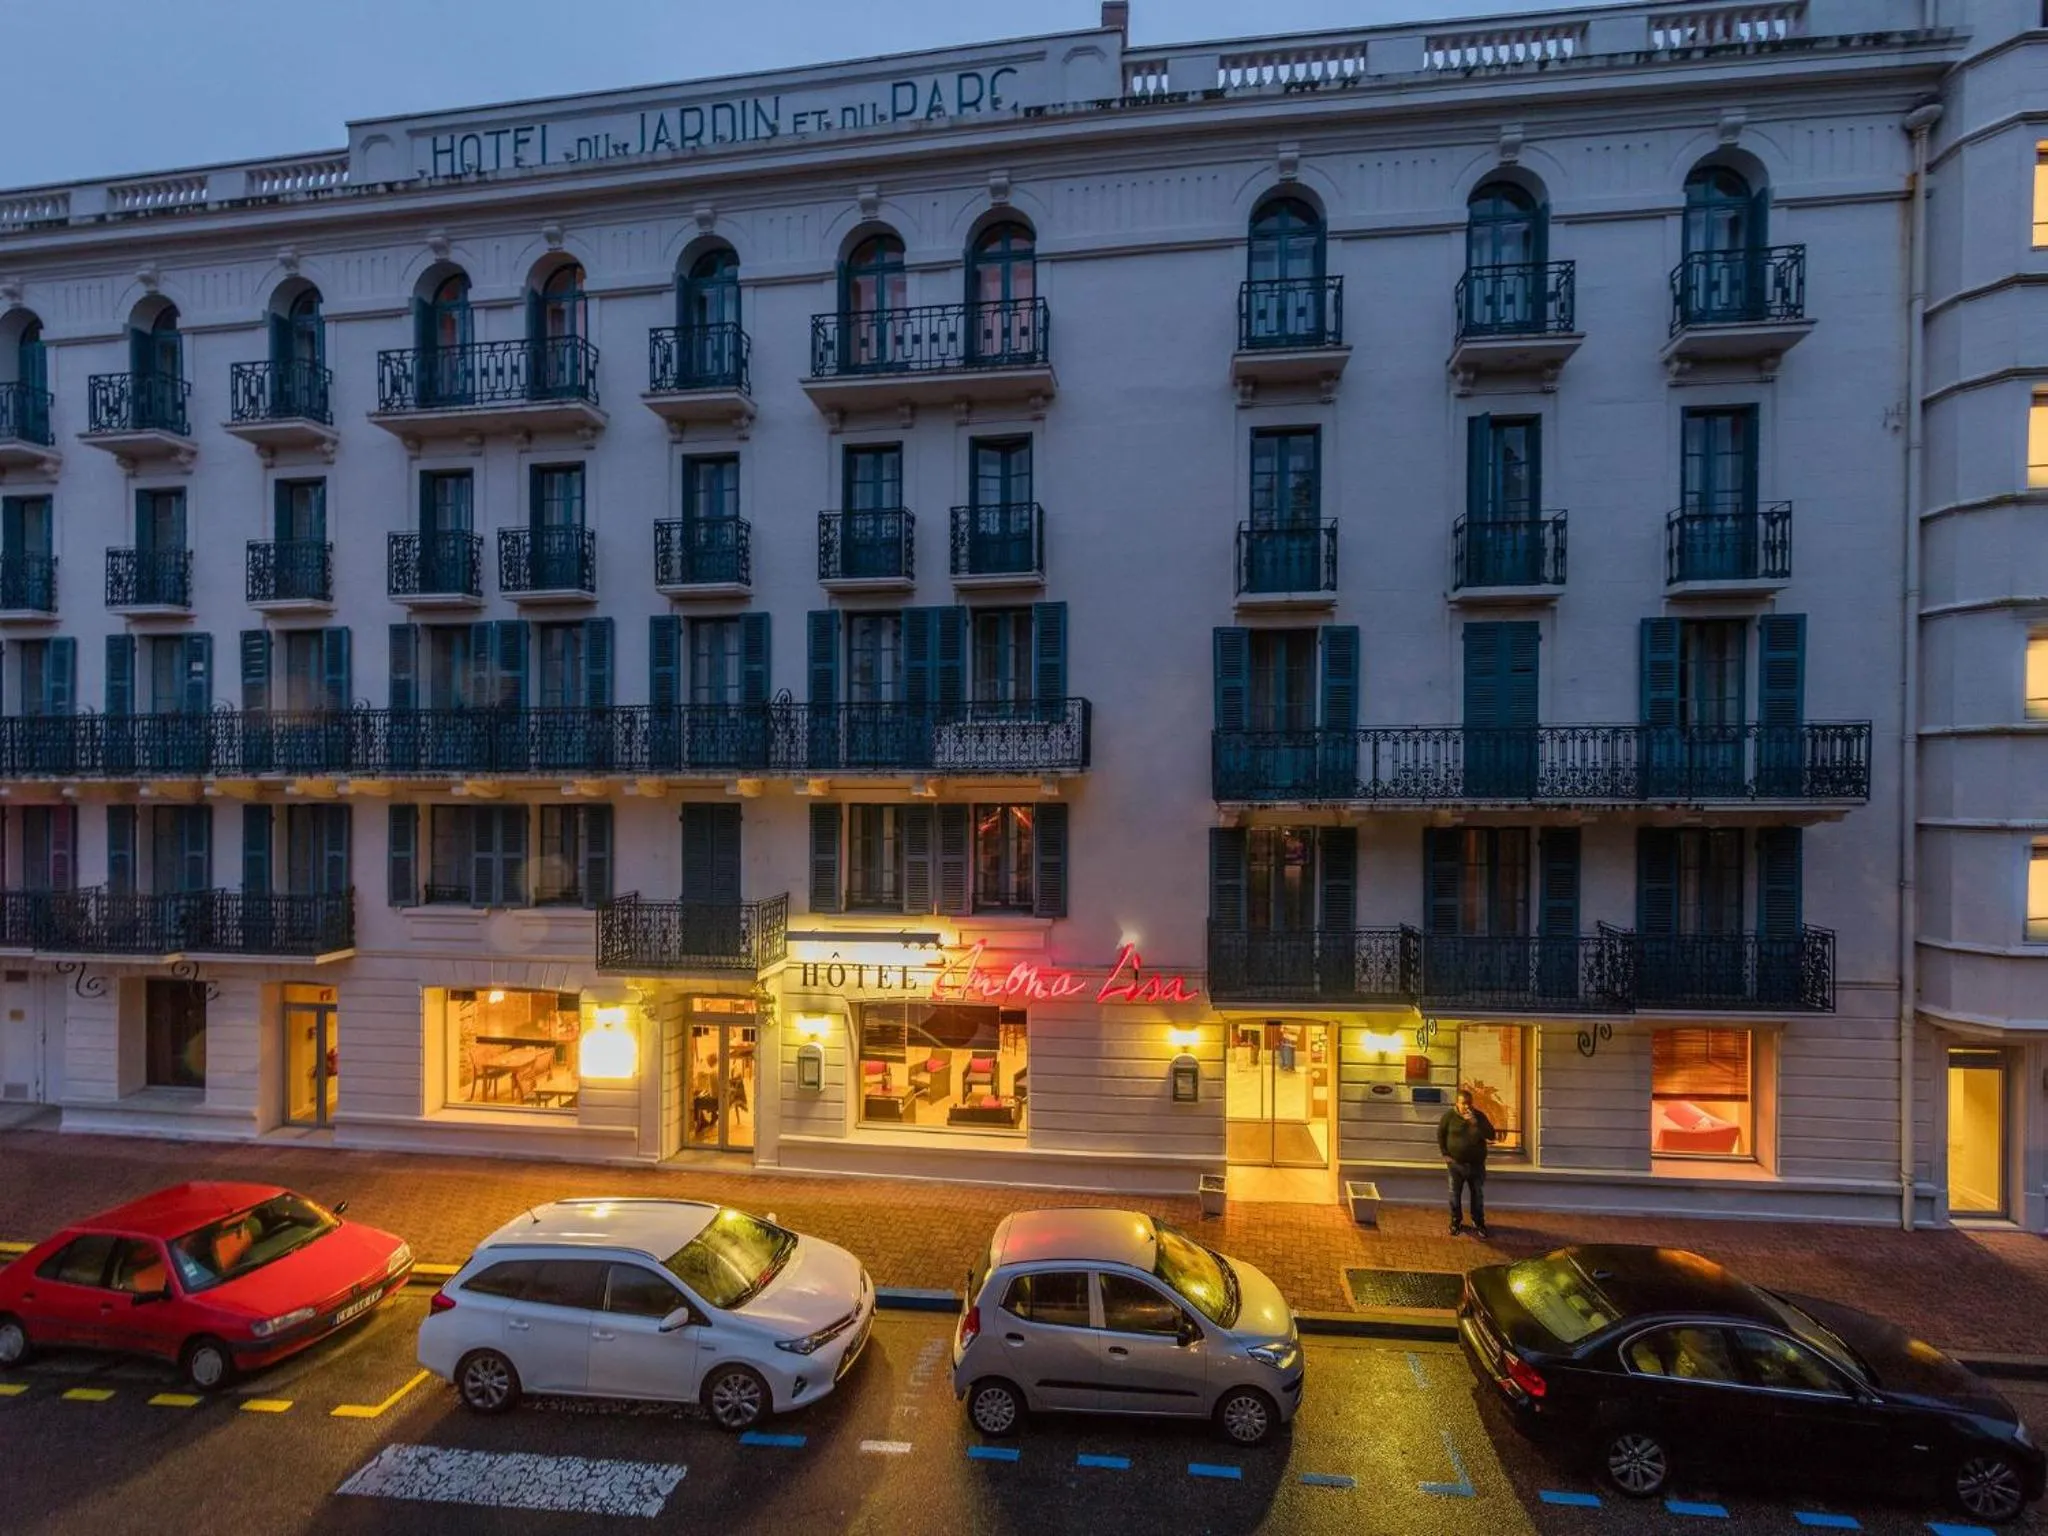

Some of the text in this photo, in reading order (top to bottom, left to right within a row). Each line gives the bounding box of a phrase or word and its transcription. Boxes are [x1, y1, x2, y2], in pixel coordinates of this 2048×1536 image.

[636, 96, 780, 153] JARDIN
[892, 67, 1018, 122] PARC
[801, 951, 918, 989] HÔTEL
[1097, 941, 1199, 1003] Lisa
